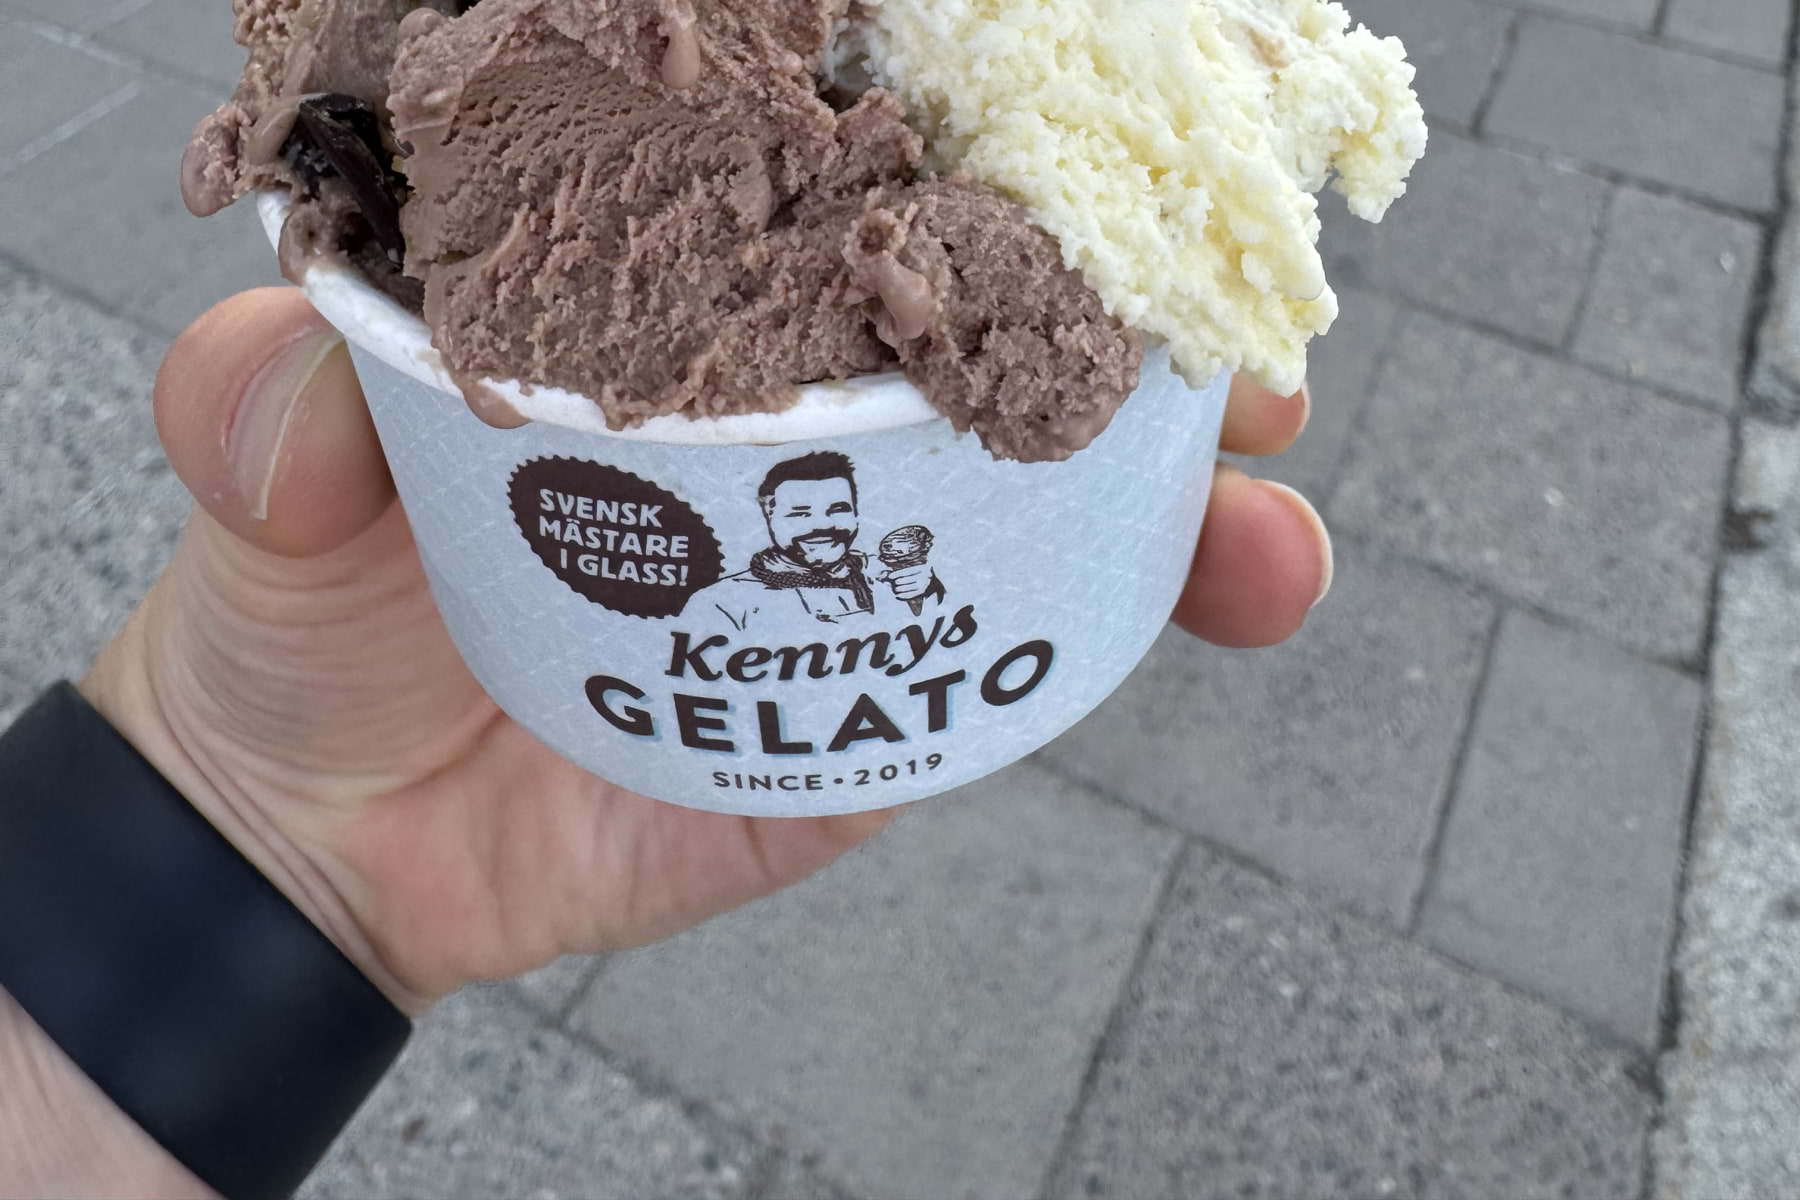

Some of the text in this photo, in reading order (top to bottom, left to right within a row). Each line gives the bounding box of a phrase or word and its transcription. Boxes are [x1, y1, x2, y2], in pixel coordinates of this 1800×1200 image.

[539, 488, 664, 528] SVENSK
[538, 515, 689, 558] MÄSTARE
[560, 548, 689, 587] I GLASS!
[664, 604, 978, 682] Kennys
[584, 639, 1055, 755] GELATO
[713, 752, 943, 792] SINCE 2019
